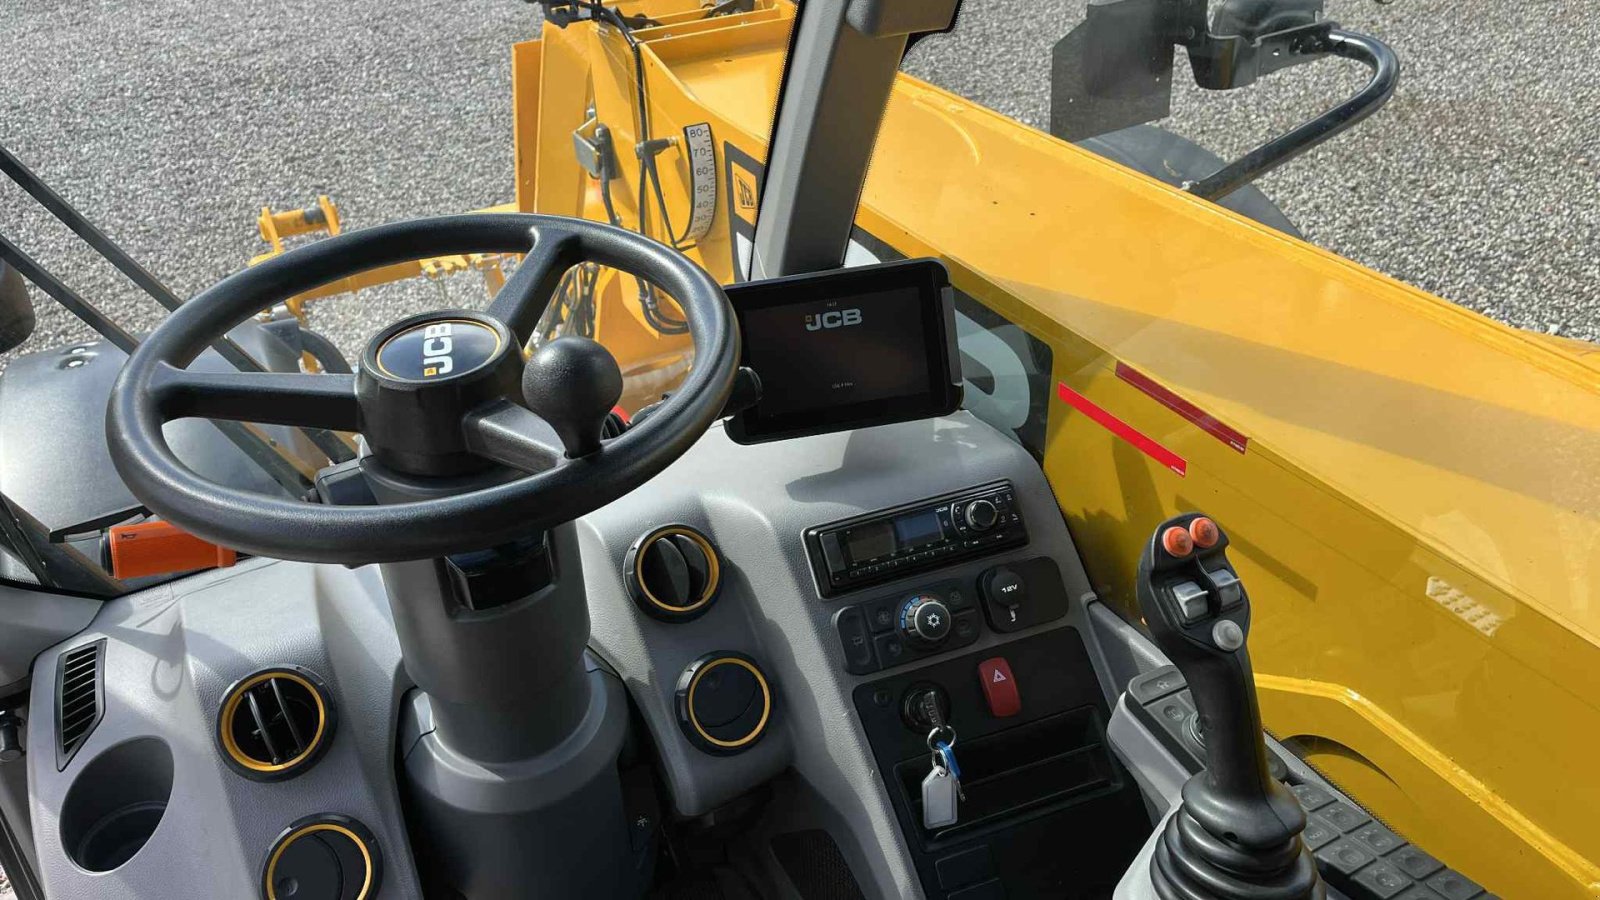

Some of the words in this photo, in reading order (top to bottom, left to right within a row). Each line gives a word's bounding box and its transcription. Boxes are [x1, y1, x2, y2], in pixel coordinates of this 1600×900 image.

[689, 127, 703, 138] 80
[693, 147, 706, 157] 70
[695, 166, 709, 176] 60
[696, 184, 710, 194] 50
[696, 200, 709, 209] 40
[805, 308, 862, 331] JCB
[423, 323, 453, 374] JCB
[1002, 584, 1018, 593] 12V
